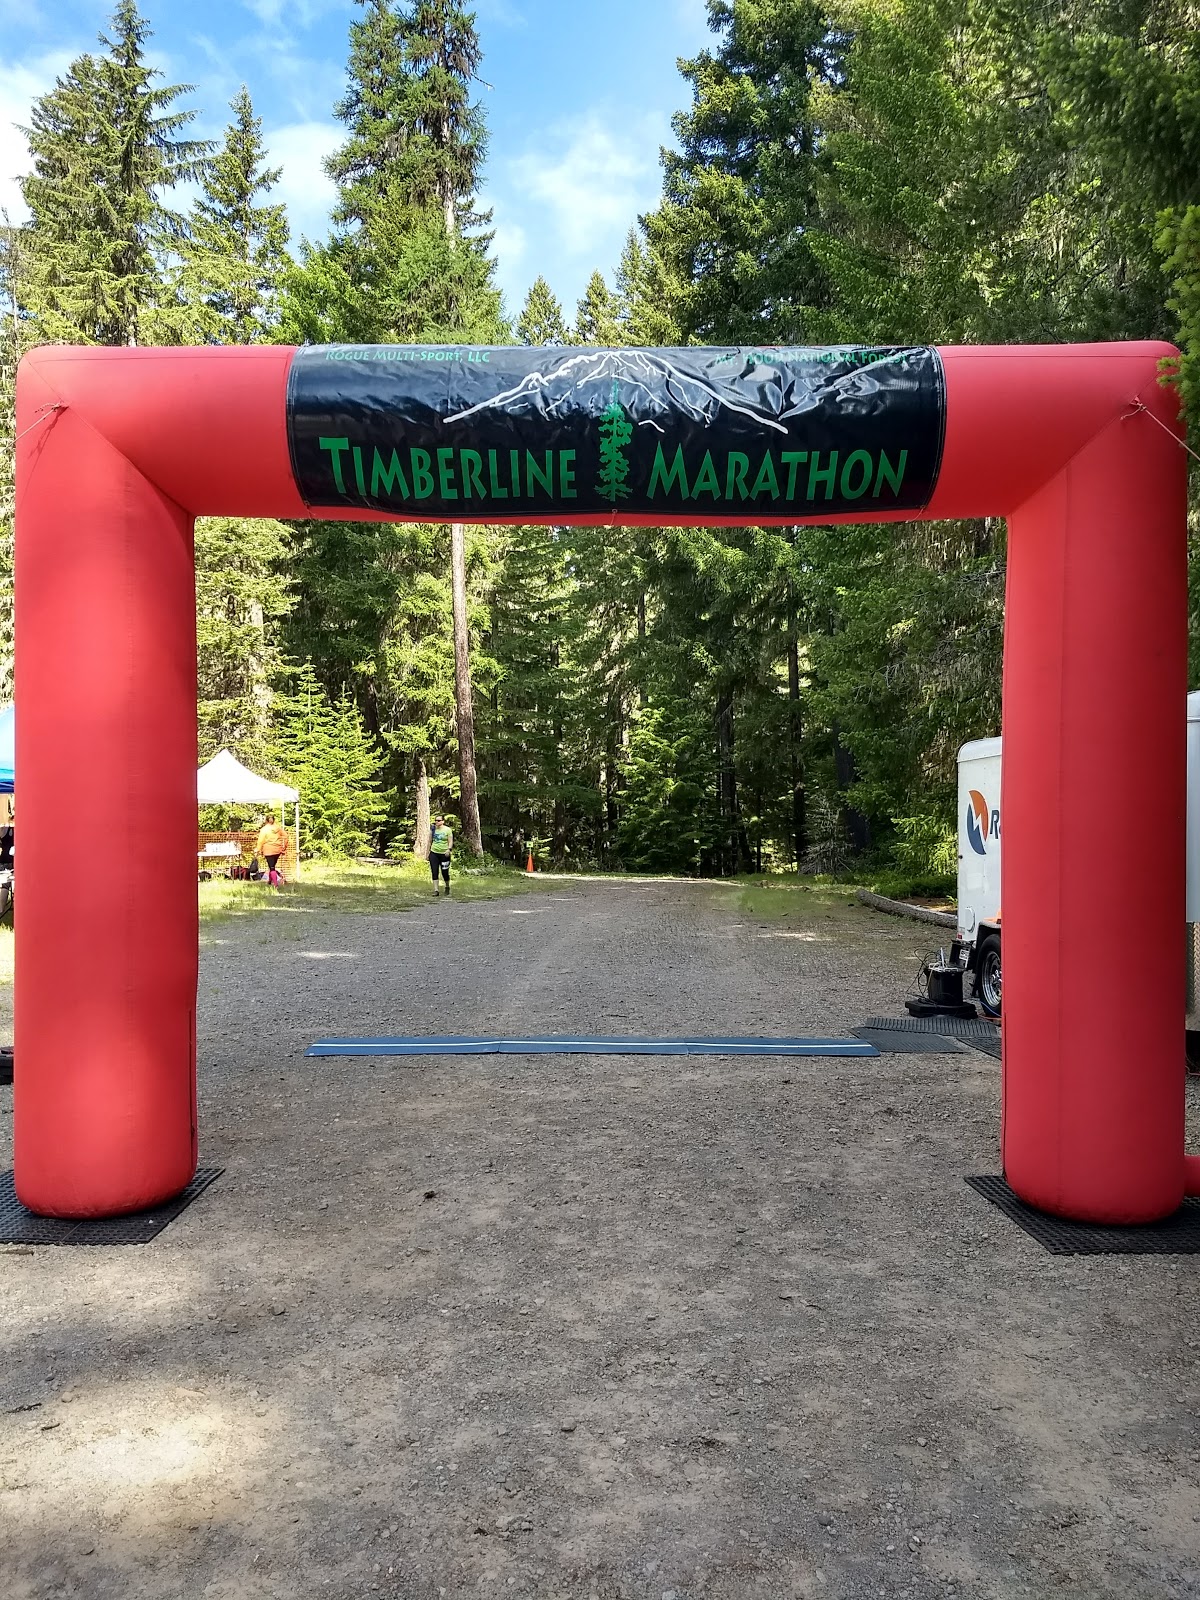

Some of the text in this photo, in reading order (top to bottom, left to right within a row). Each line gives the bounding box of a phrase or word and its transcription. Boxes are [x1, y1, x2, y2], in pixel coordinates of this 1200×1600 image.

[325, 350, 491, 363] ROGUE MULTI-SPORT, LLC
[319, 436, 908, 501] TIMBERLINE MARATHON
